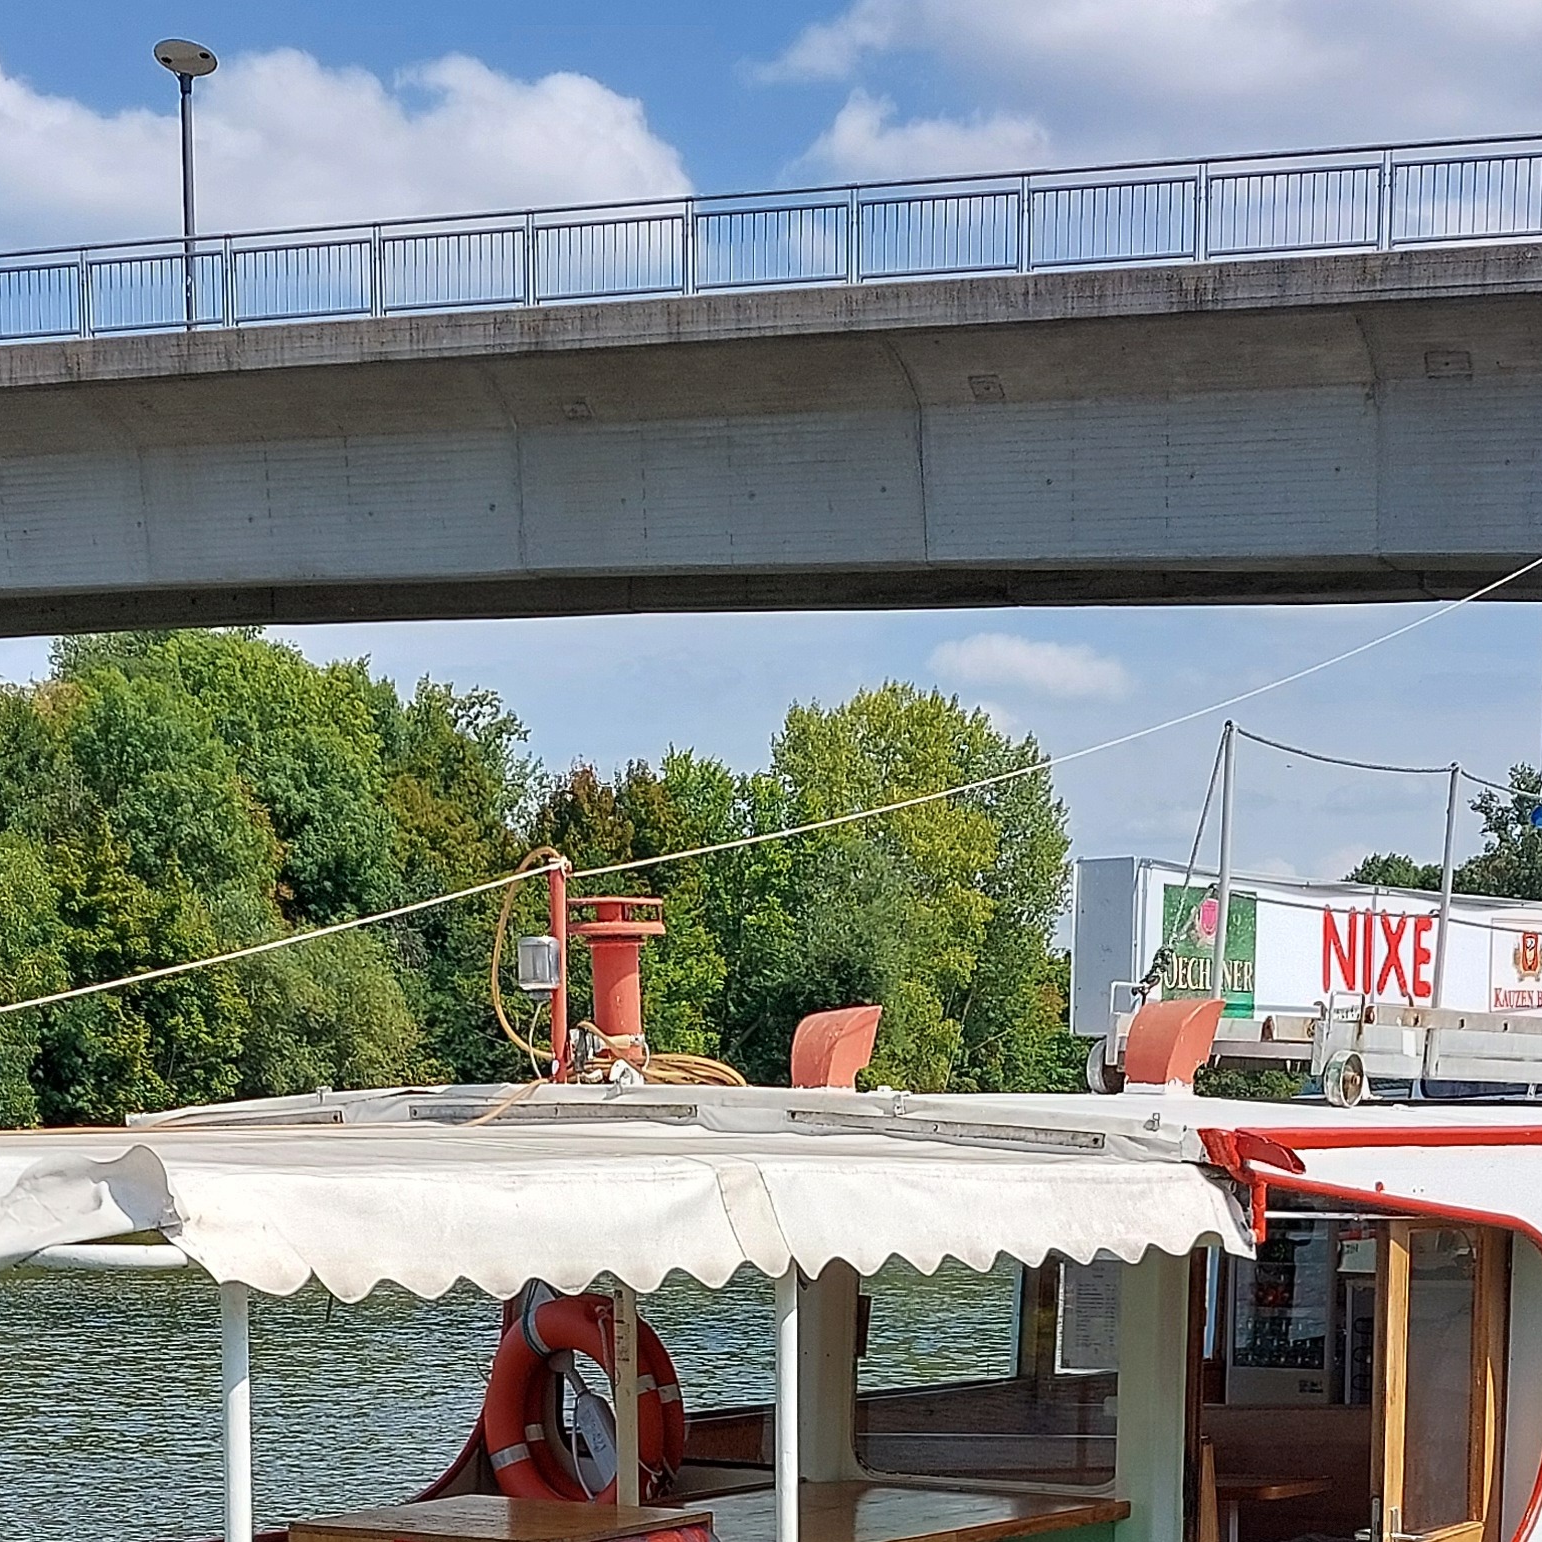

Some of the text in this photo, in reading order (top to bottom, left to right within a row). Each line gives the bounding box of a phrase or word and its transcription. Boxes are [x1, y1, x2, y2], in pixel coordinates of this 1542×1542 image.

[1162, 951, 1253, 993] OECHNER
[1322, 904, 1433, 998] NIXE
[1493, 987, 1534, 1009] KAUZEN
